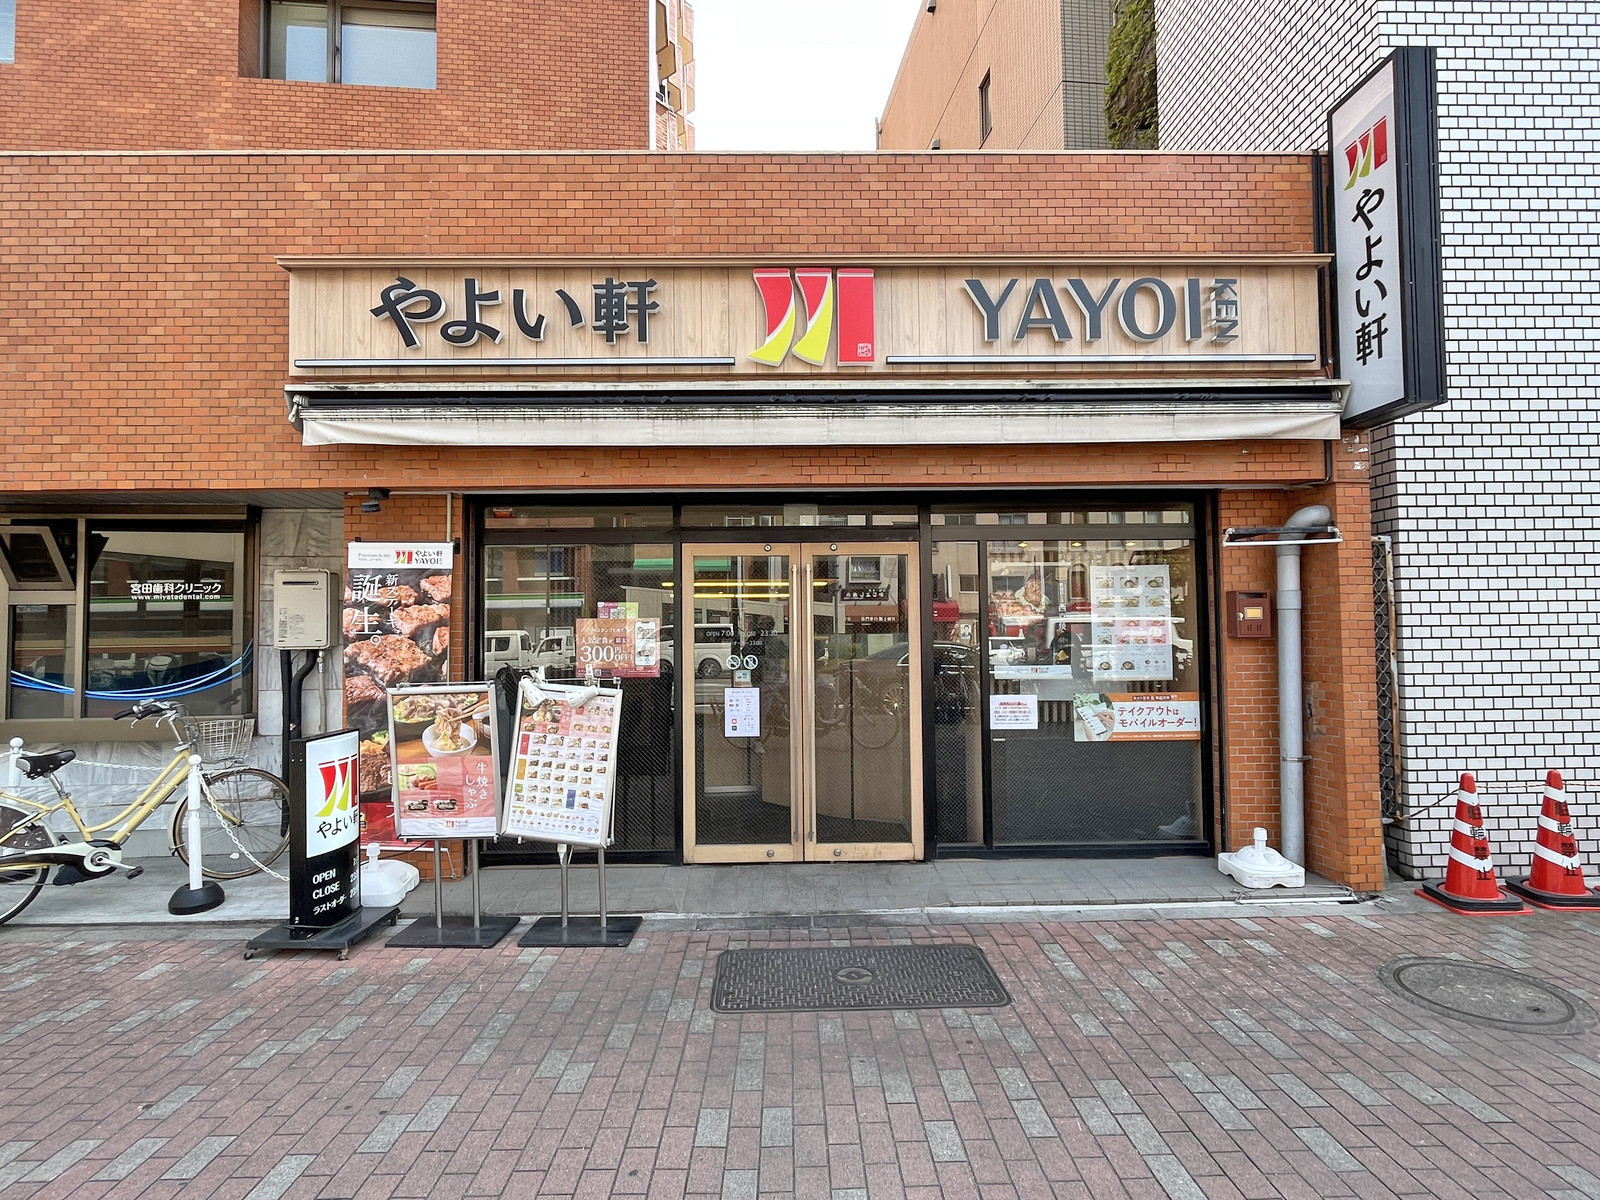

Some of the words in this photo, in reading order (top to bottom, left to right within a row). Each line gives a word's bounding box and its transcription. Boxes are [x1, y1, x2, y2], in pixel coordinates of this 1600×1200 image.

[1351, 188, 1389, 366] やよい軒
[370, 276, 661, 350] やよい軒
[964, 277, 1201, 343] YAYOI
[1210, 278, 1239, 343] KEN
[130, 583, 222, 594] 宮田歯科クリニック
[351, 573, 383, 646] 誕生。
[580, 645, 615, 662] 300
[1118, 706, 1179, 716] テイクアウトは
[465, 774, 478, 808] しゃぶ
[476, 762, 488, 800] 牛焼き
[312, 868, 336, 884] OPEN
[312, 881, 340, 900] CLOSE
